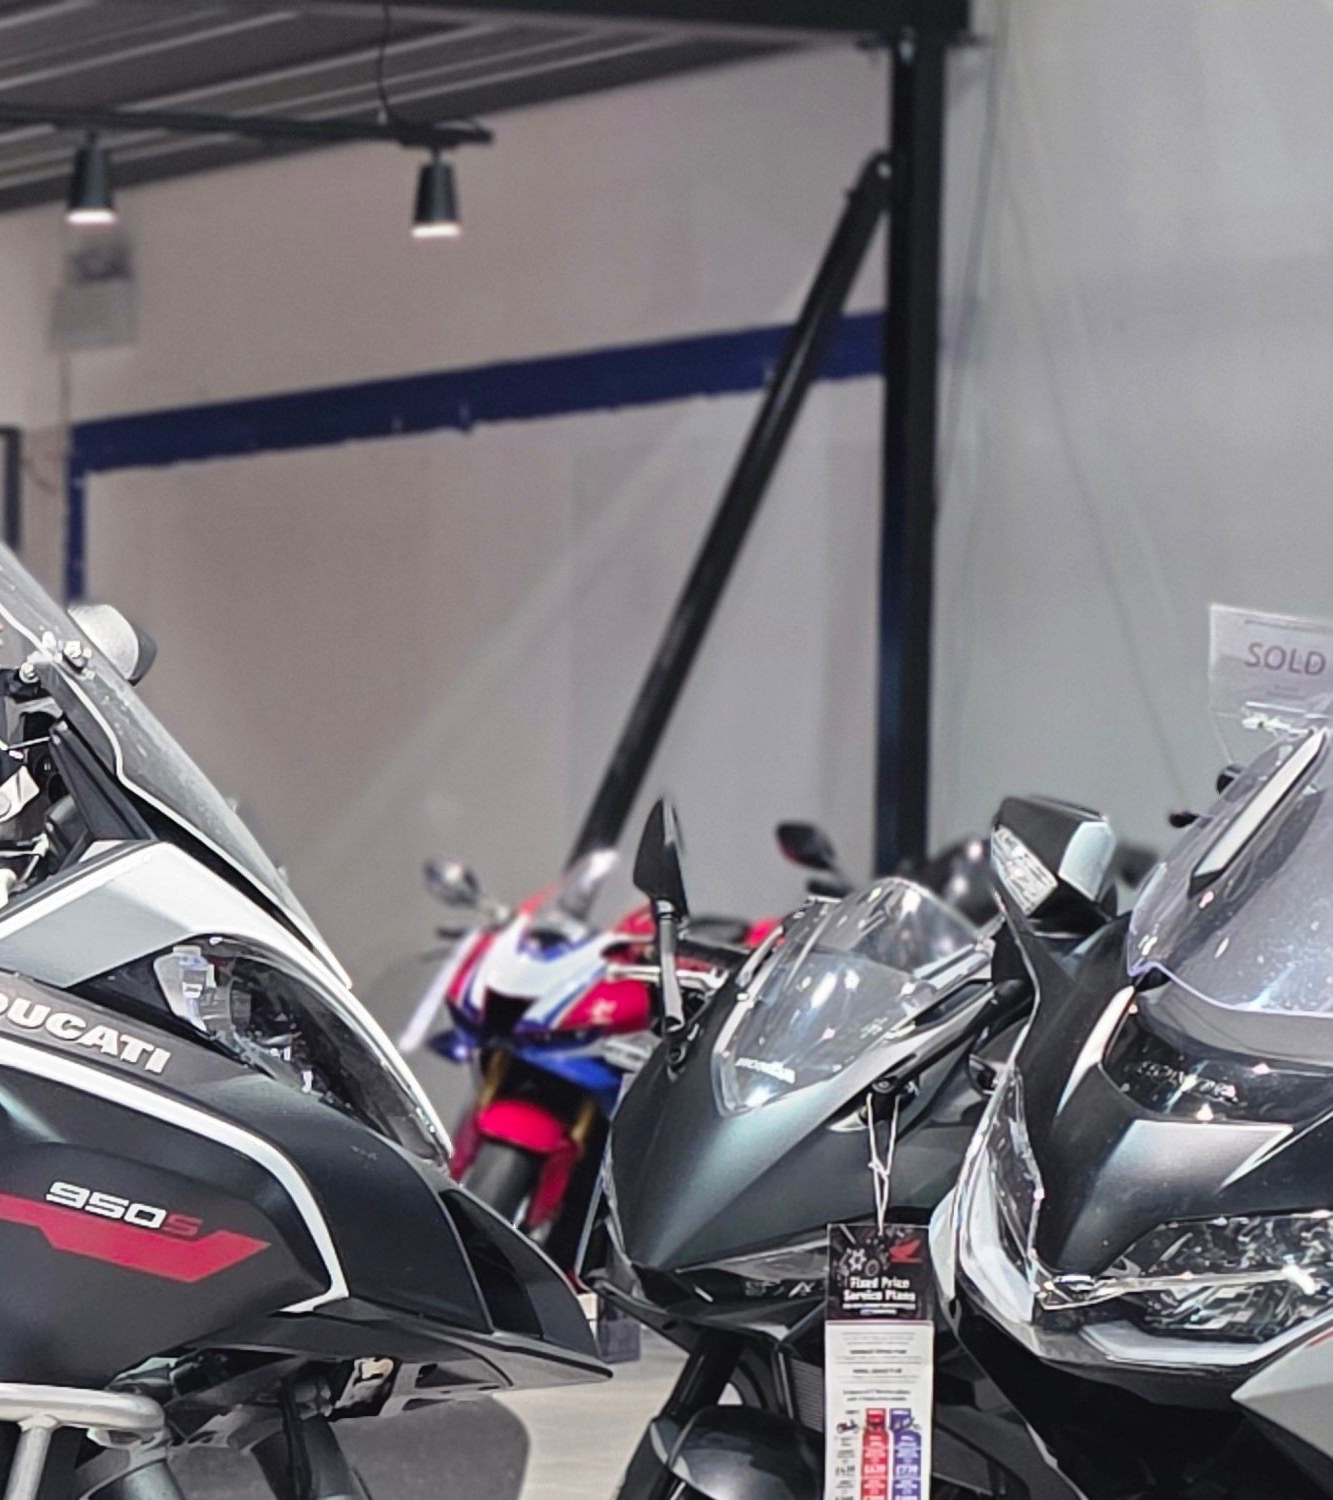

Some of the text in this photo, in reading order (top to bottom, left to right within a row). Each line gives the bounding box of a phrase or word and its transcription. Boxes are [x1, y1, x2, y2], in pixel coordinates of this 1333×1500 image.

[1244, 642, 1326, 675] SOLD
[850, 1276, 910, 1289] Fixed Price
[843, 1290, 916, 1302] Service Plans
